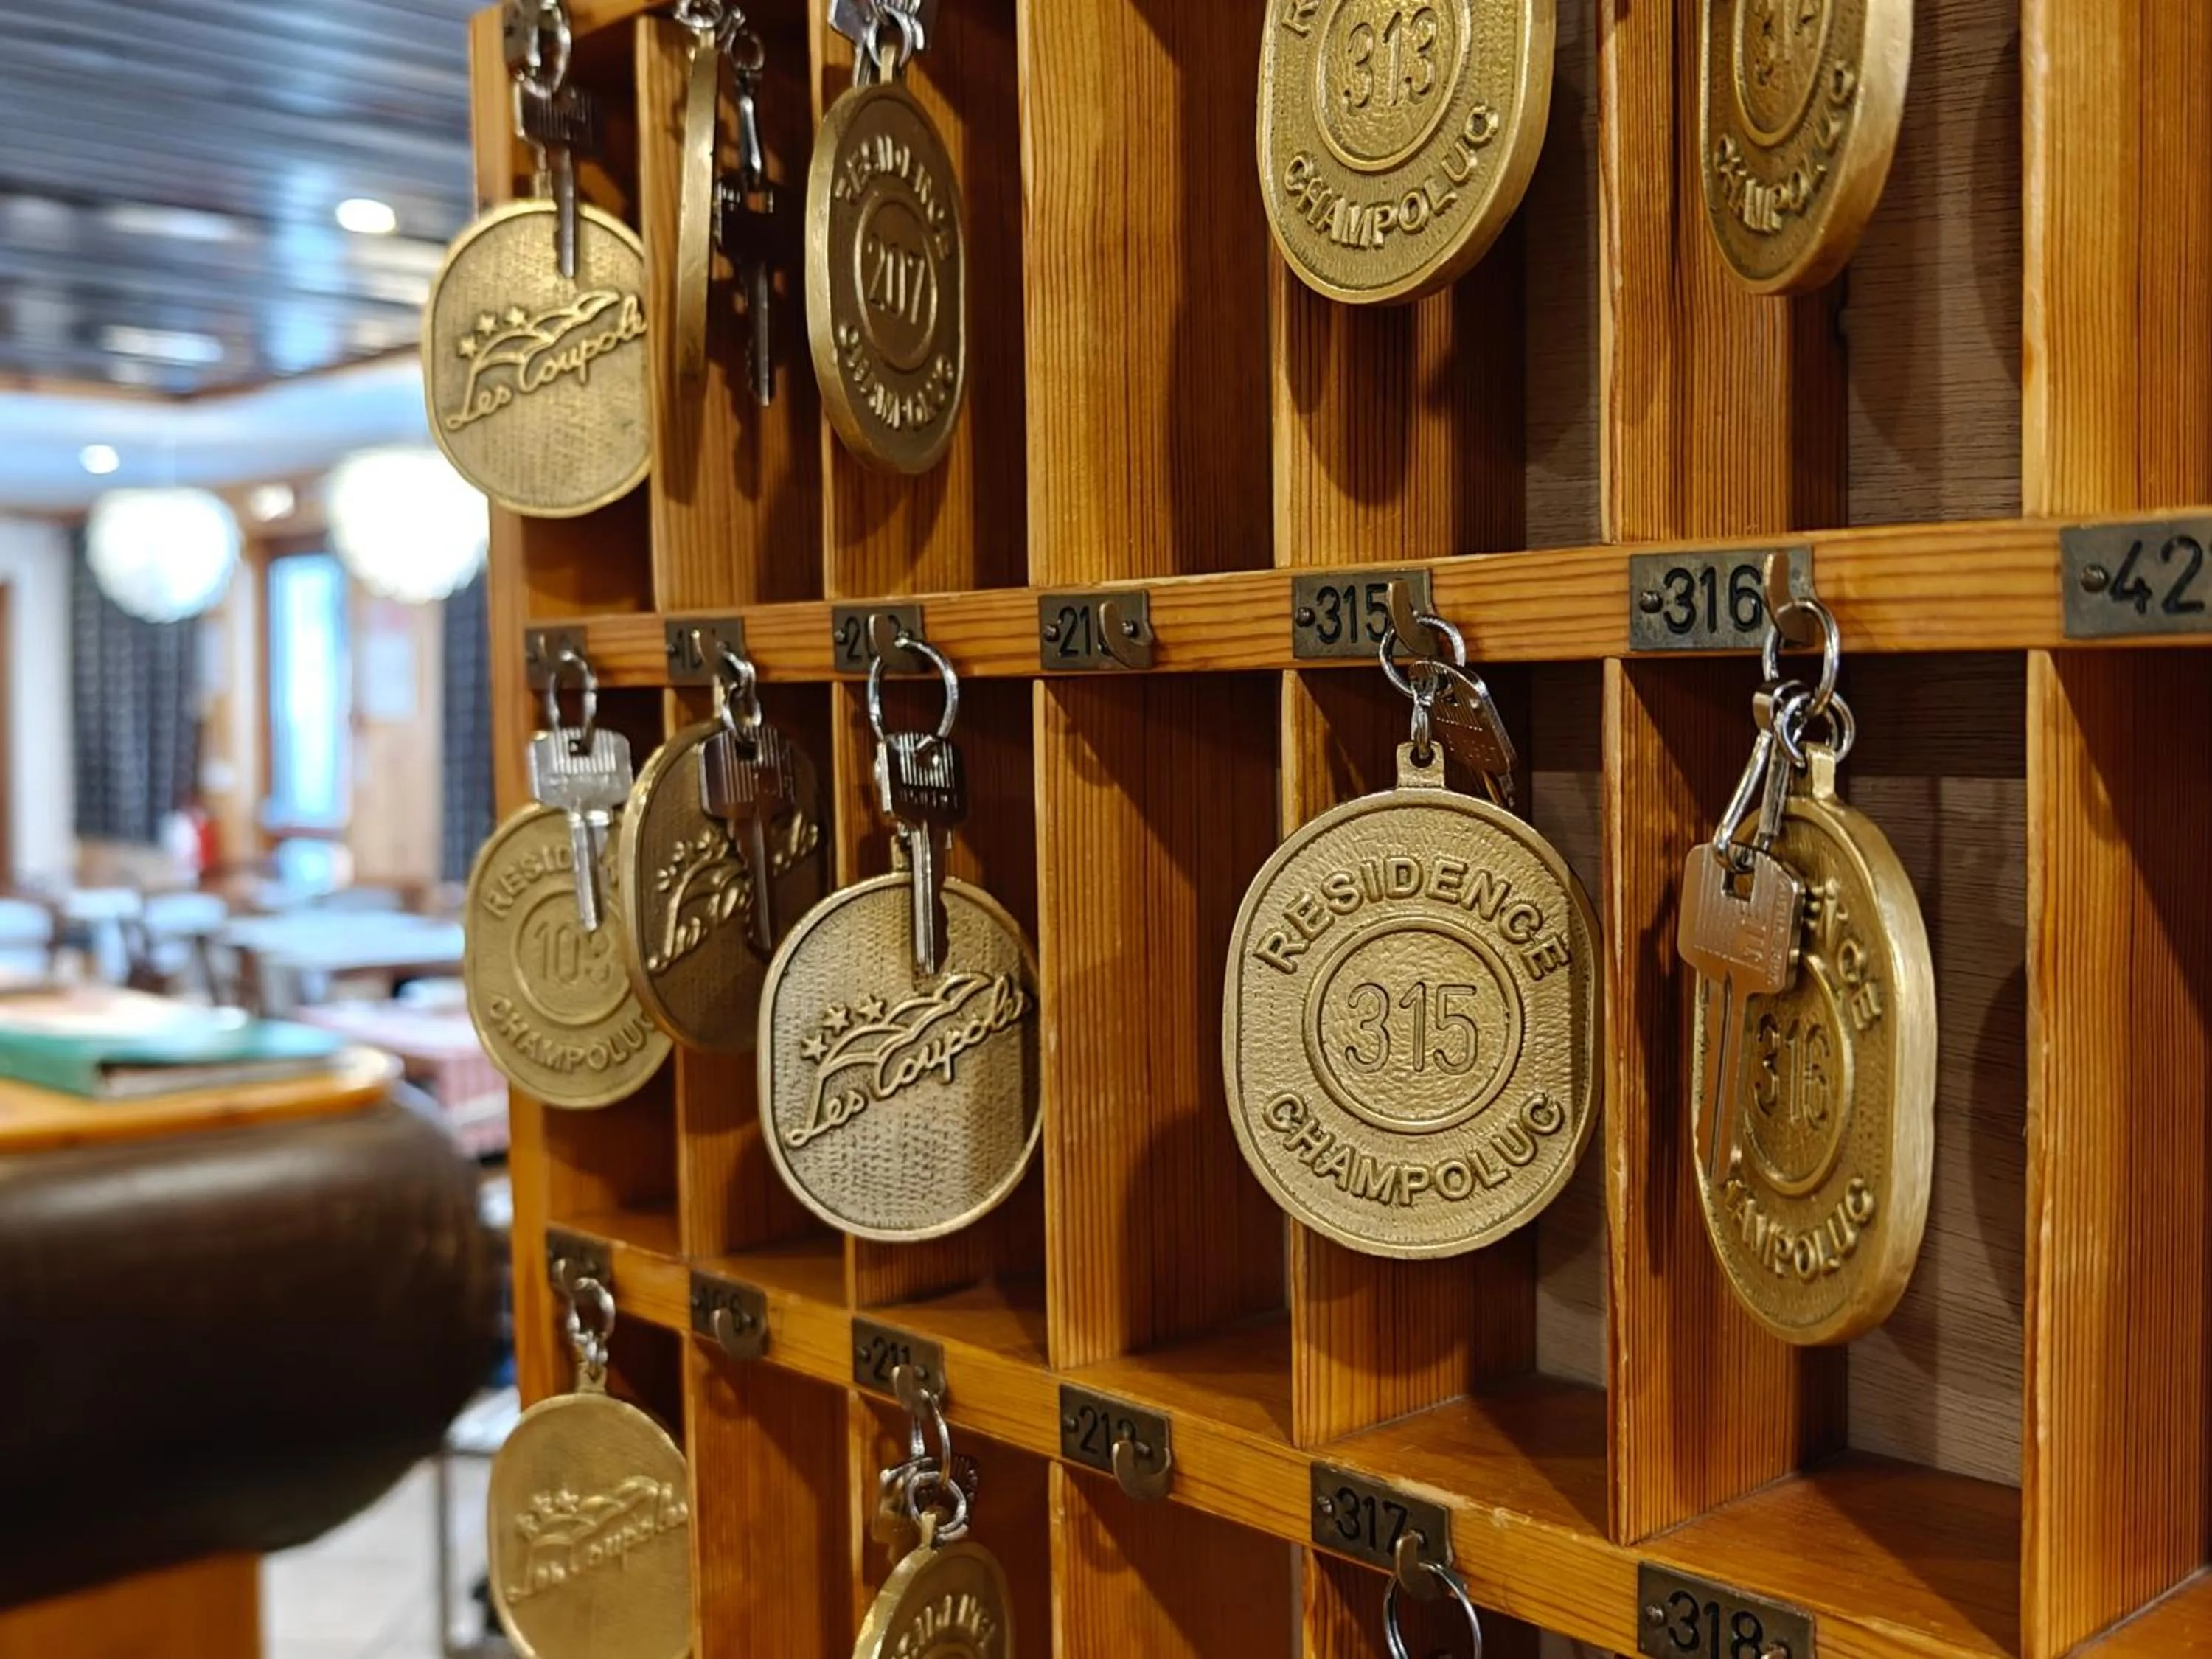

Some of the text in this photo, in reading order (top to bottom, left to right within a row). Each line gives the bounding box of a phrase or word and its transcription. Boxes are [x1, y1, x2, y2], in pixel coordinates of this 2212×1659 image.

[1343, 6, 1439, 111] 313
[1284, 102, 1500, 249] CHAMPOLUC
[866, 233, 926, 325] 207
[518, 294, 647, 393] Coupole
[1316, 583, 1391, 644] 315
[1663, 564, 1764, 635] 316
[2108, 534, 2212, 615] 42
[1057, 605, 1112, 658] 21
[1254, 856, 1571, 981] RESIDENCE
[1344, 981, 1479, 1076] 315
[1756, 1012, 1830, 1131] 316
[786, 1069, 865, 1147] Les
[1262, 1090, 1565, 1206] CHAMPOLUC
[1335, 1486, 1408, 1557] 317
[1667, 1590, 1764, 1659] 318
